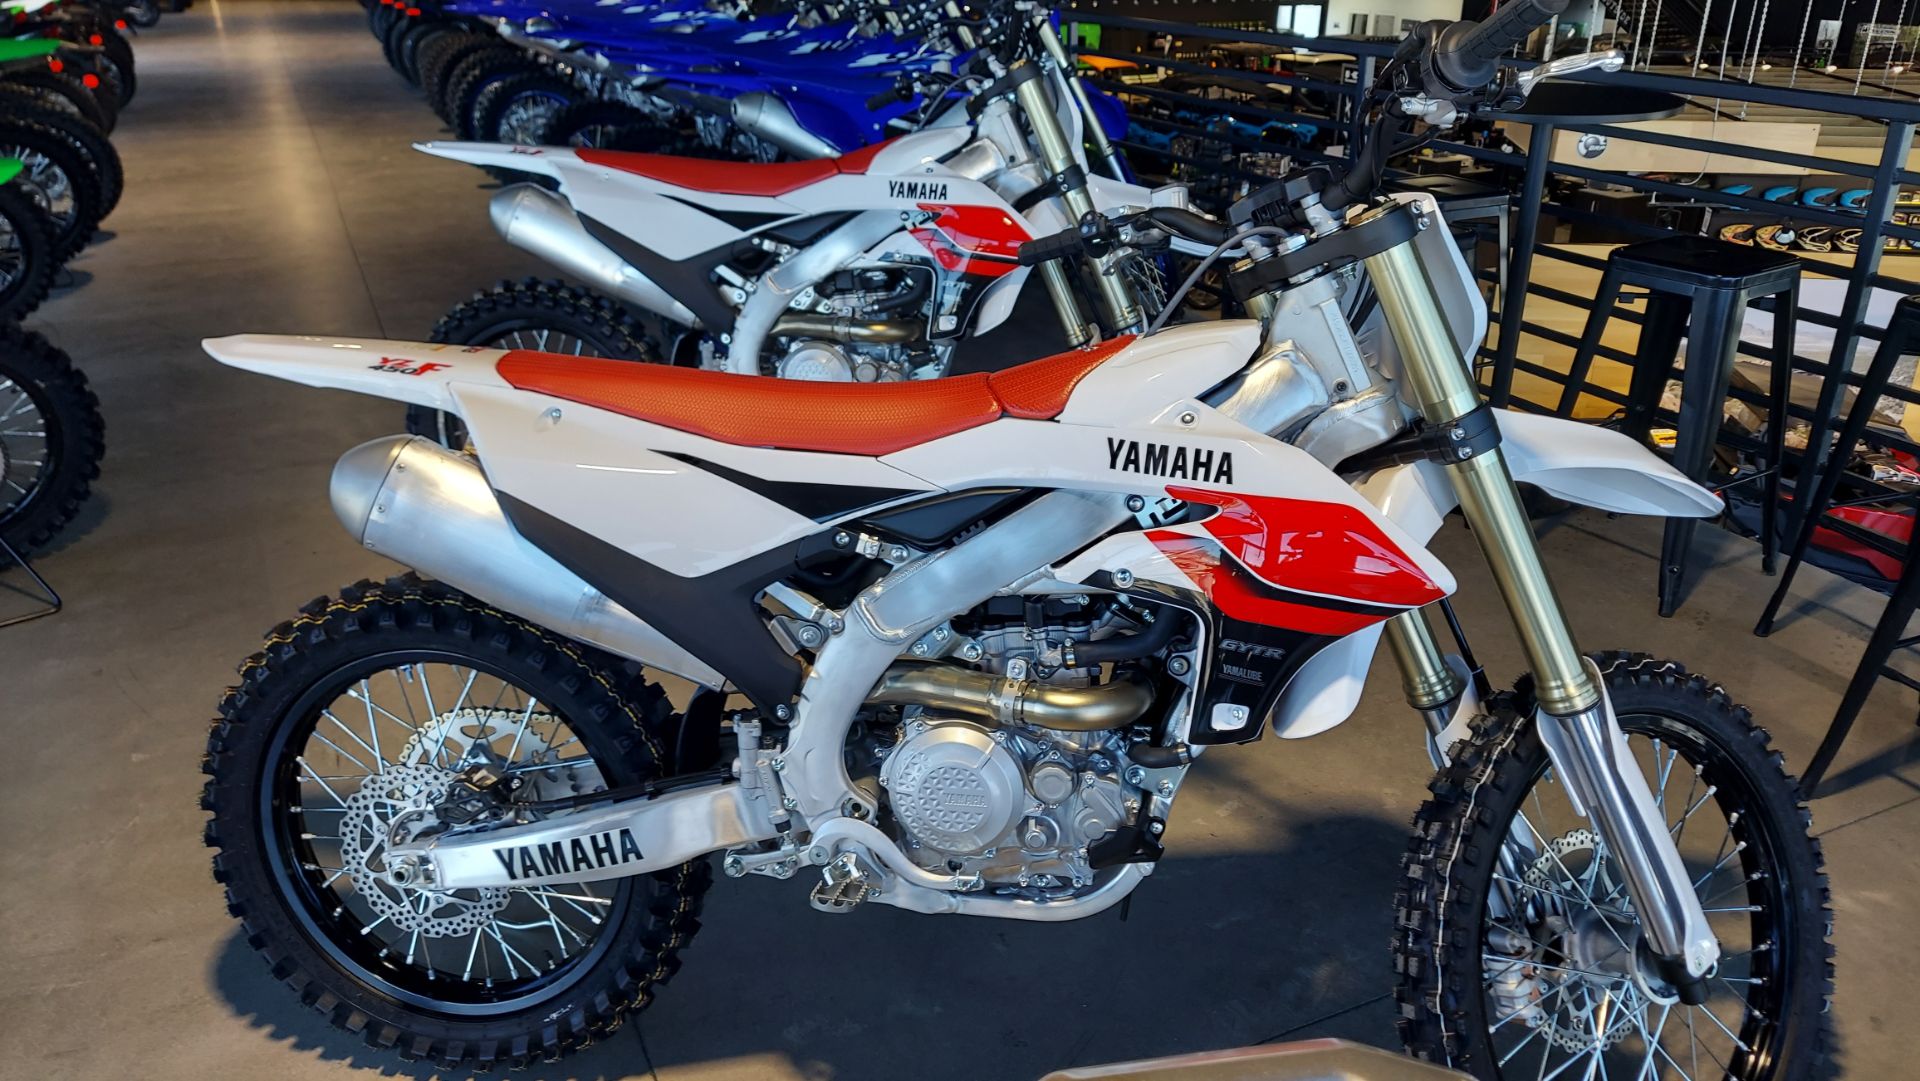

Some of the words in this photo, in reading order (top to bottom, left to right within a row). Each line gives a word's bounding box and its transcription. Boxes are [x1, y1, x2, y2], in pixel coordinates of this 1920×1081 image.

[889, 180, 947, 200] YAMAHA
[1107, 437, 1233, 484] YAMAHA
[1219, 639, 1286, 659] GYTR
[1223, 664, 1263, 681] YAMALUBE
[943, 792, 988, 807] YAMAHA
[493, 828, 644, 880] YAMAHA
